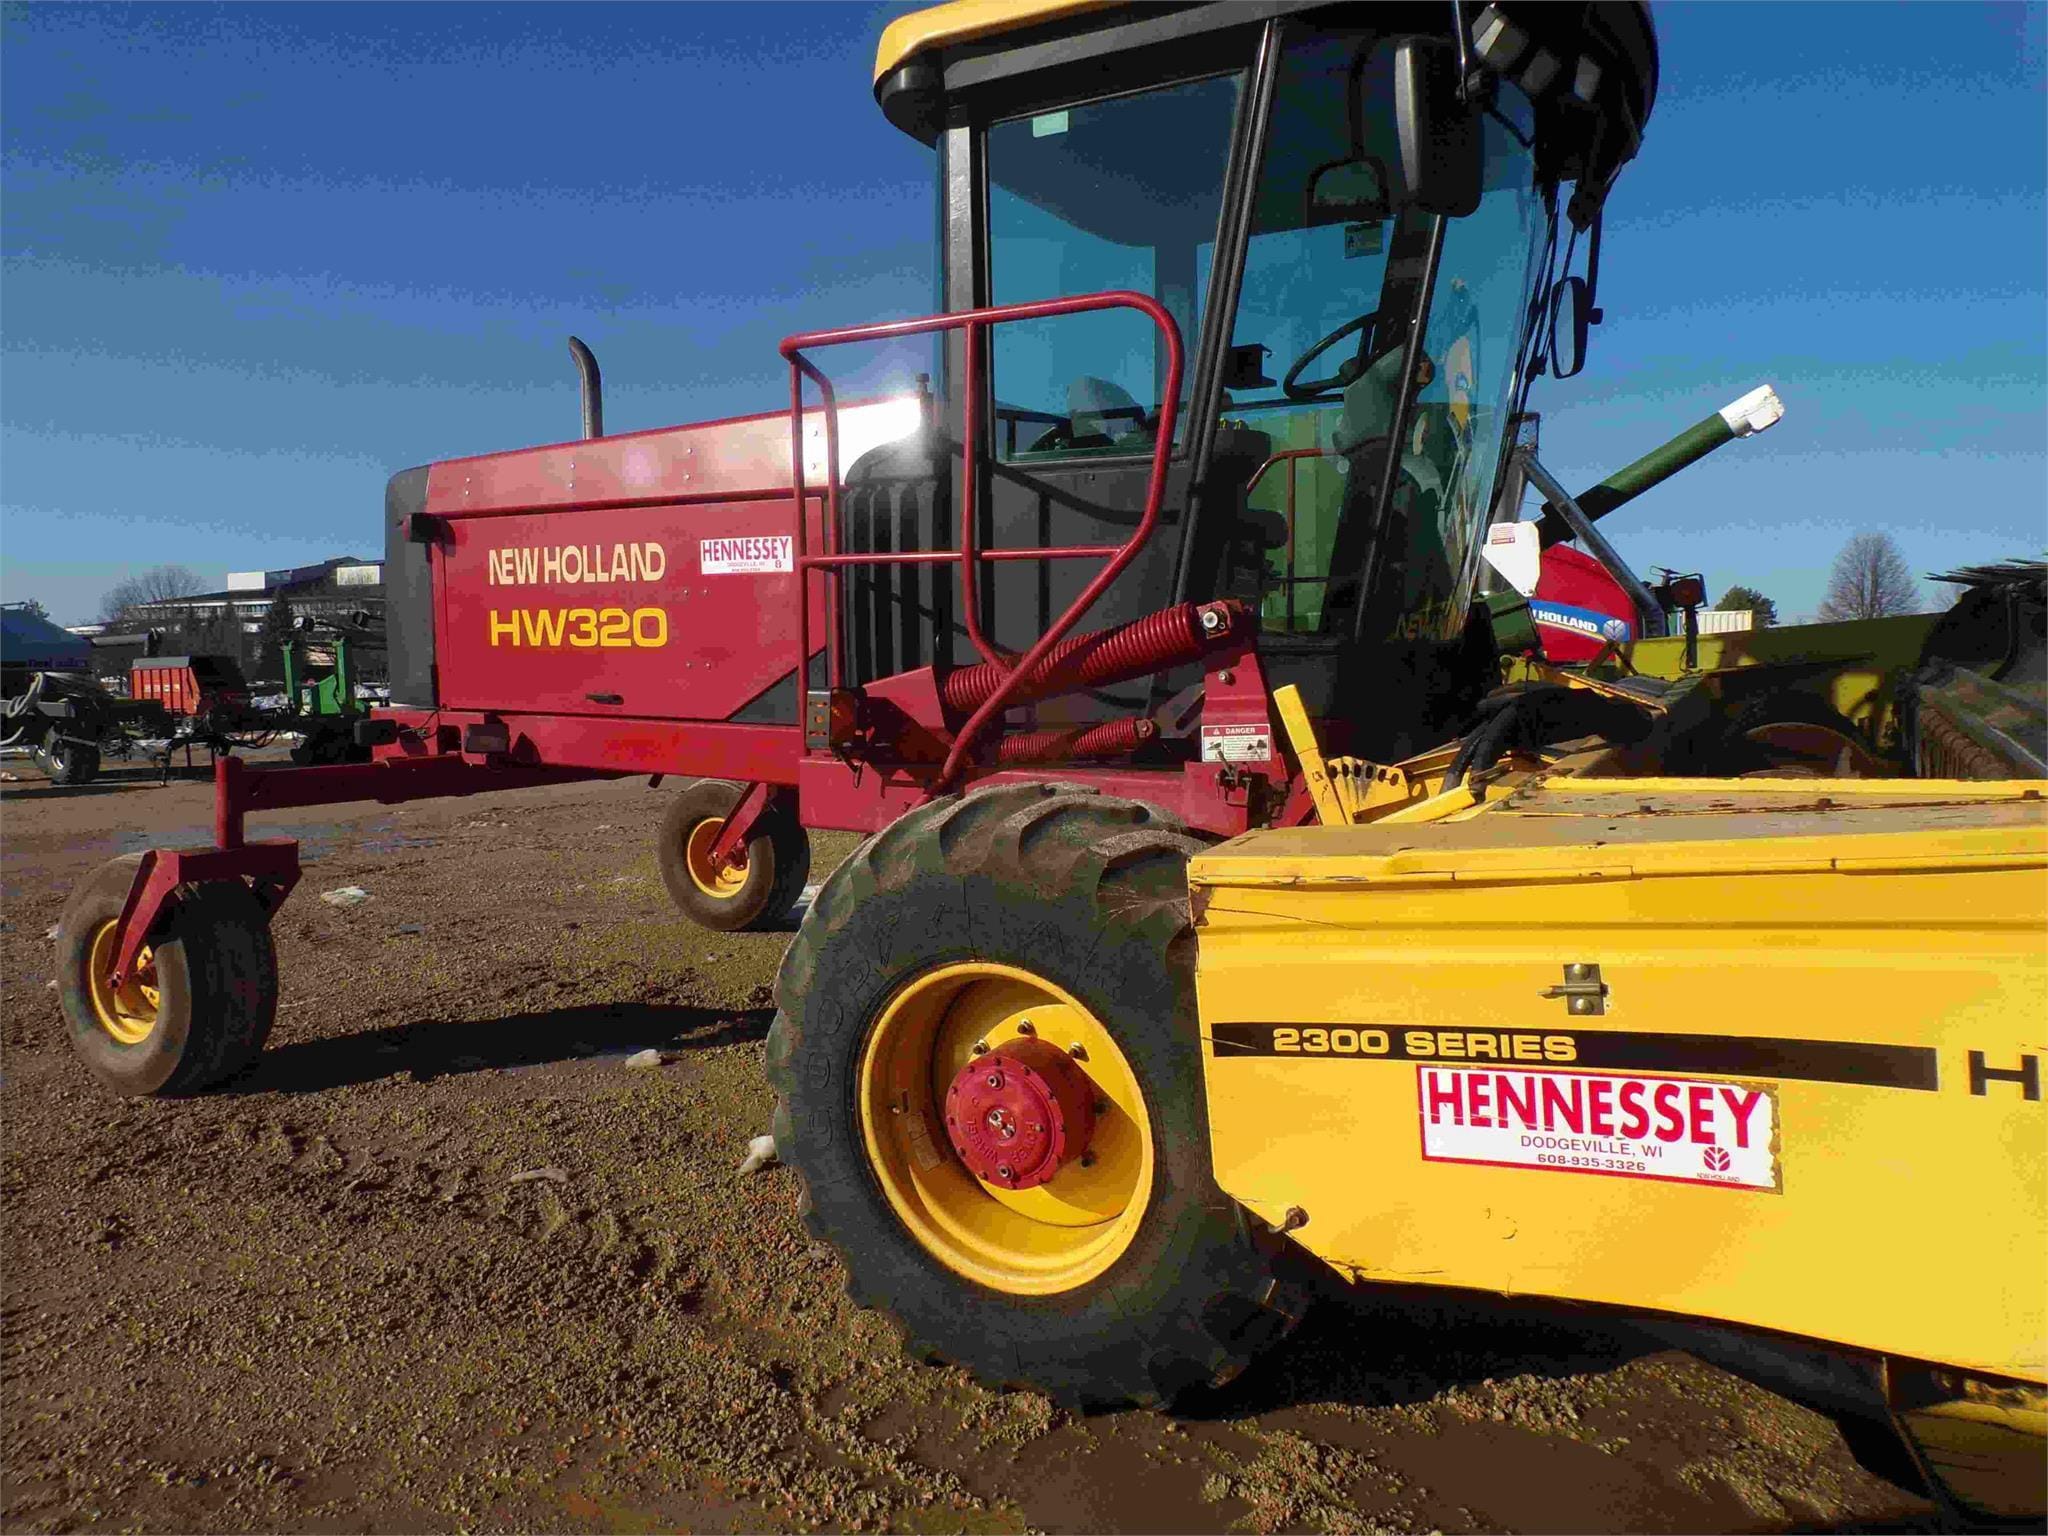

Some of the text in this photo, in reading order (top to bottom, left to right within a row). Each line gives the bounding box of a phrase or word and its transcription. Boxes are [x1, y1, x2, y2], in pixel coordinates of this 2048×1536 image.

[489, 542, 667, 586] NEW HOLLAND
[702, 537, 789, 562] HENNESSEY
[489, 608, 668, 648] HW320
[1538, 610, 1598, 633] HOLLAND
[1225, 726, 1256, 735] DANGER
[1272, 1027, 1578, 1062] 2300 SERIES
[1967, 1049, 2041, 1102] H
[1427, 1070, 1764, 1149] HENNESSEY
[1520, 1134, 1663, 1159] DODGEVILLE, WI
[1537, 1153, 1647, 1172] 608-935-3326
